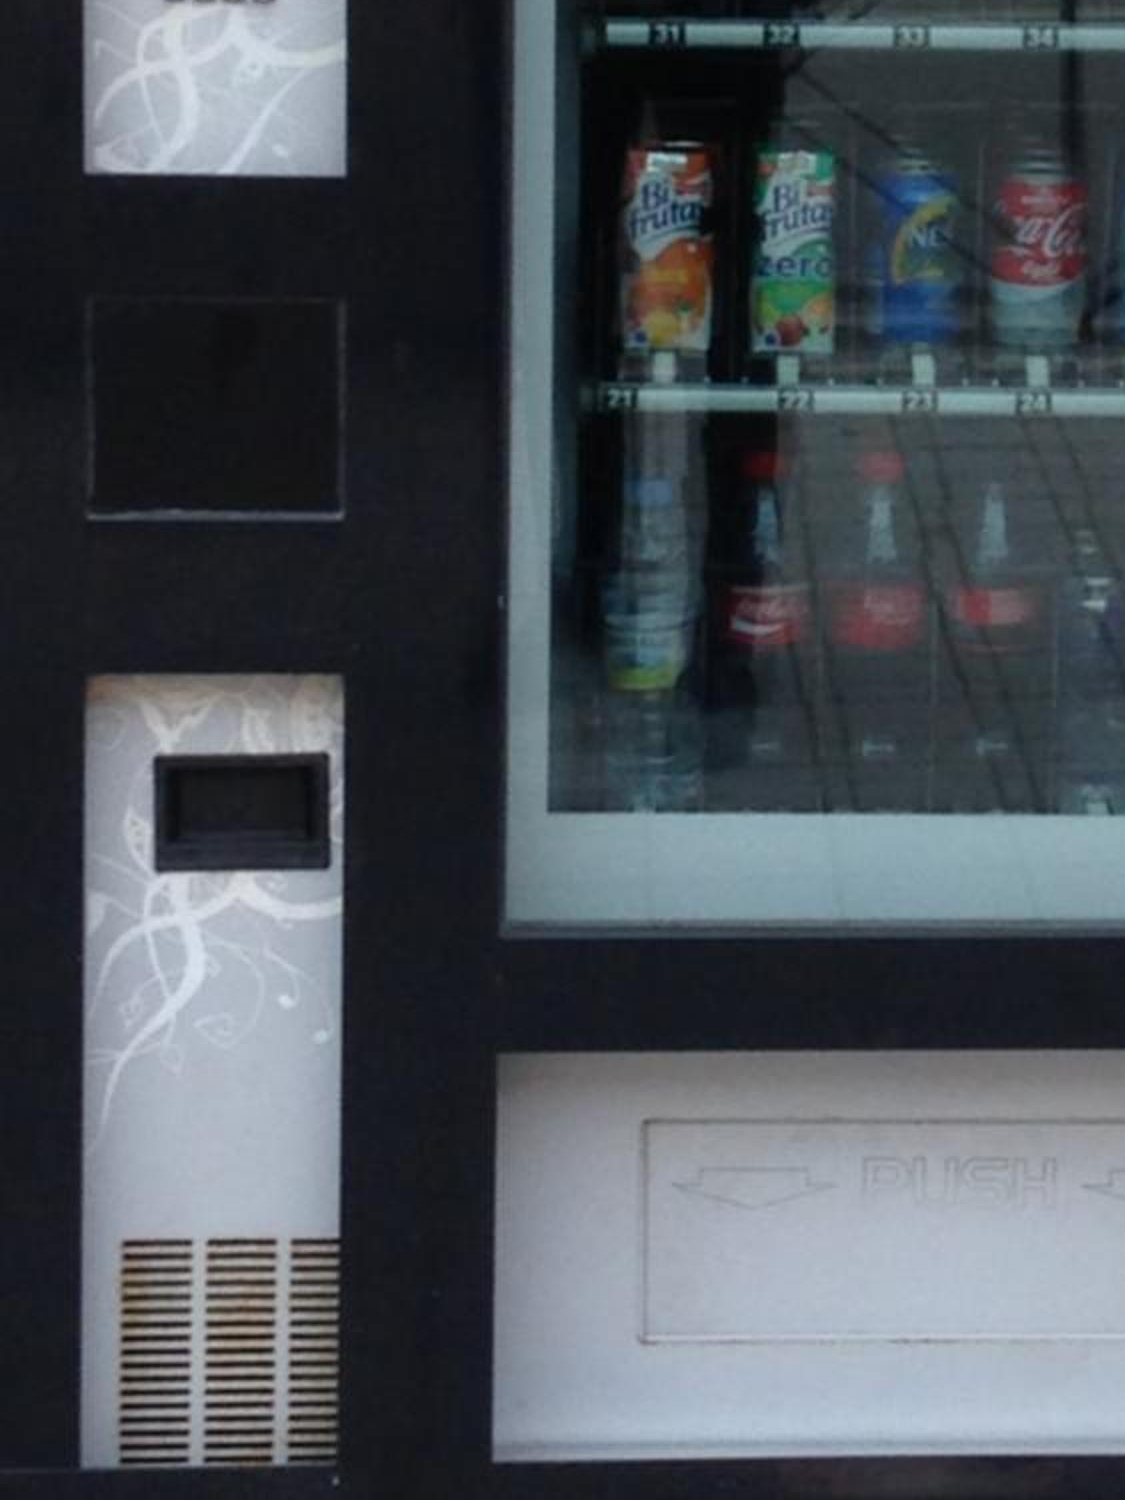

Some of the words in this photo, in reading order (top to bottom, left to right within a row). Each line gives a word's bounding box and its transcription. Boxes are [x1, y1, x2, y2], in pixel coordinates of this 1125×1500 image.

[653, 25, 681, 44] 31
[767, 26, 795, 45] 32
[898, 27, 925, 46] 33
[1026, 28, 1057, 48] 34
[640, 180, 669, 211] Bi
[773, 184, 800, 214] Bi
[608, 389, 636, 408] 21
[782, 390, 810, 409] 22
[862, 1155, 1057, 1205] PUSH
